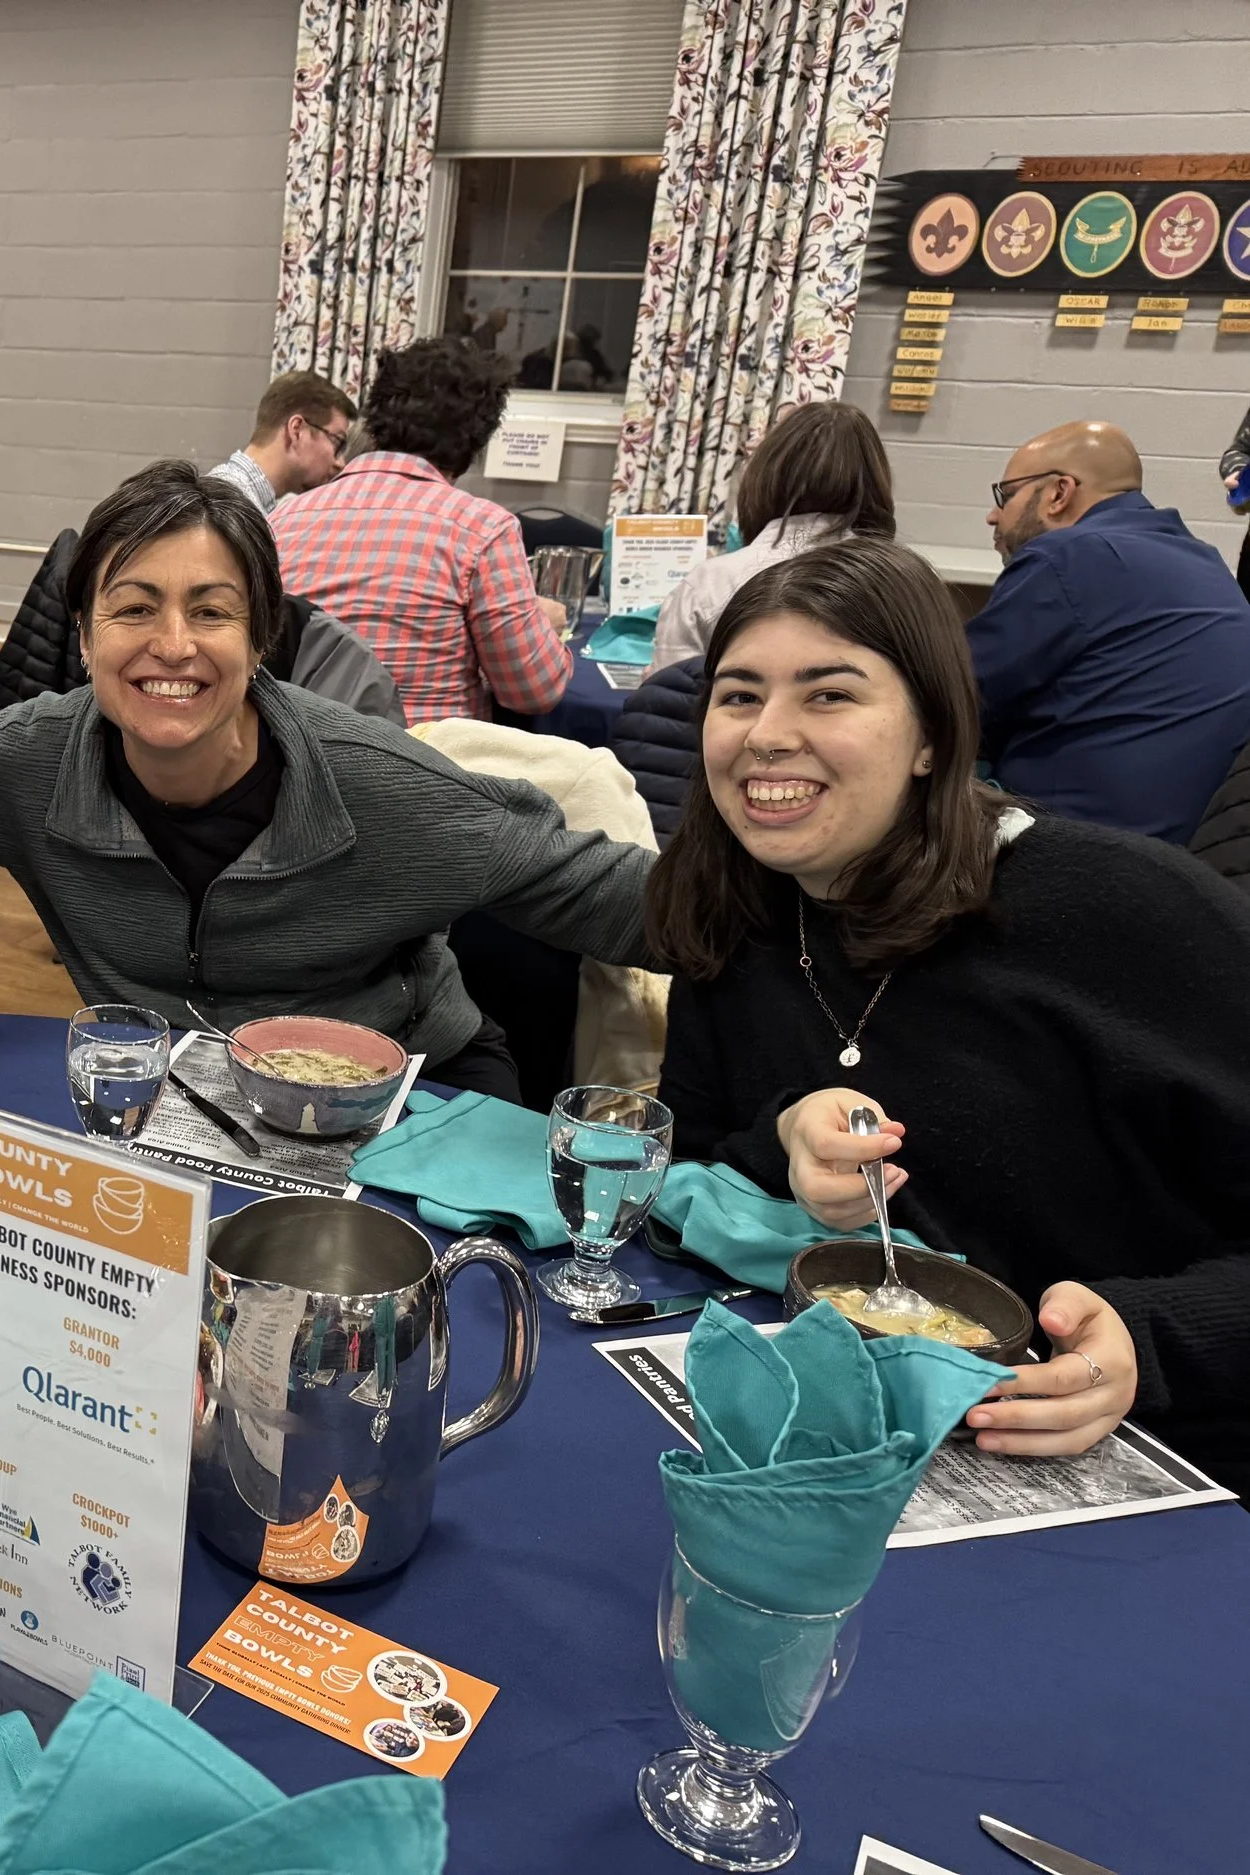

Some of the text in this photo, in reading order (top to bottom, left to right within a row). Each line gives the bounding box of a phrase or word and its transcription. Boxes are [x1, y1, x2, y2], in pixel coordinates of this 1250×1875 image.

[1032, 159, 1144, 178] SCOUTING
[1177, 160, 1199, 175] IS
[174, 1155, 214, 1172] Food
[216, 1165, 275, 1187] County
[12, 1203, 44, 1220] CHANGE
[44, 1213, 60, 1226] THE
[61, 1218, 89, 1234] WORLD
[32, 1238, 95, 1275] COUNTY
[101, 1260, 155, 1297] EMPTY
[43, 1270, 136, 1319] SPONSORS:
[62, 1316, 120, 1350] GRANTOR
[69, 1339, 112, 1368] $4,000
[629, 1354, 686, 1404] Pantries
[22, 1365, 134, 1434] Qlarant
[16, 1403, 31, 1415] Best
[31, 1409, 56, 1426] People.
[56, 1420, 71, 1432] Best
[72, 1427, 106, 1447] Solutions.
[107, 1441, 122, 1454] Best
[1, 1502, 17, 1516] Wye
[72, 1492, 131, 1528] CROCKPOT
[80, 1514, 119, 1540] $1000+
[11, 1543, 28, 1566] Inn
[68, 1543, 103, 1568] TALBOT
[105, 1550, 133, 1599] FAMILY
[69, 1575, 129, 1615] NETWORK
[258, 1589, 354, 1640] TALBOT
[233, 1614, 326, 1662] EMPTY
[246, 1603, 348, 1654] COUNTY
[51, 1634, 114, 1670] BLUEPOINT
[222, 1628, 314, 1678] BOWLS
[199, 1659, 213, 1669] SAVE
[213, 1664, 223, 1674] THE
[222, 1669, 235, 1679] DATE
[235, 1675, 245, 1685] FOR
[245, 1680, 257, 1691] OUR
[256, 1685, 270, 1697] 2025
[270, 1693, 301, 1711] COMMUNITY
[300, 1707, 331, 1725] GATHERING
[206, 1651, 352, 1725] THANK YOU, PREVIOUS EMPTY BOWLS DONORS!
